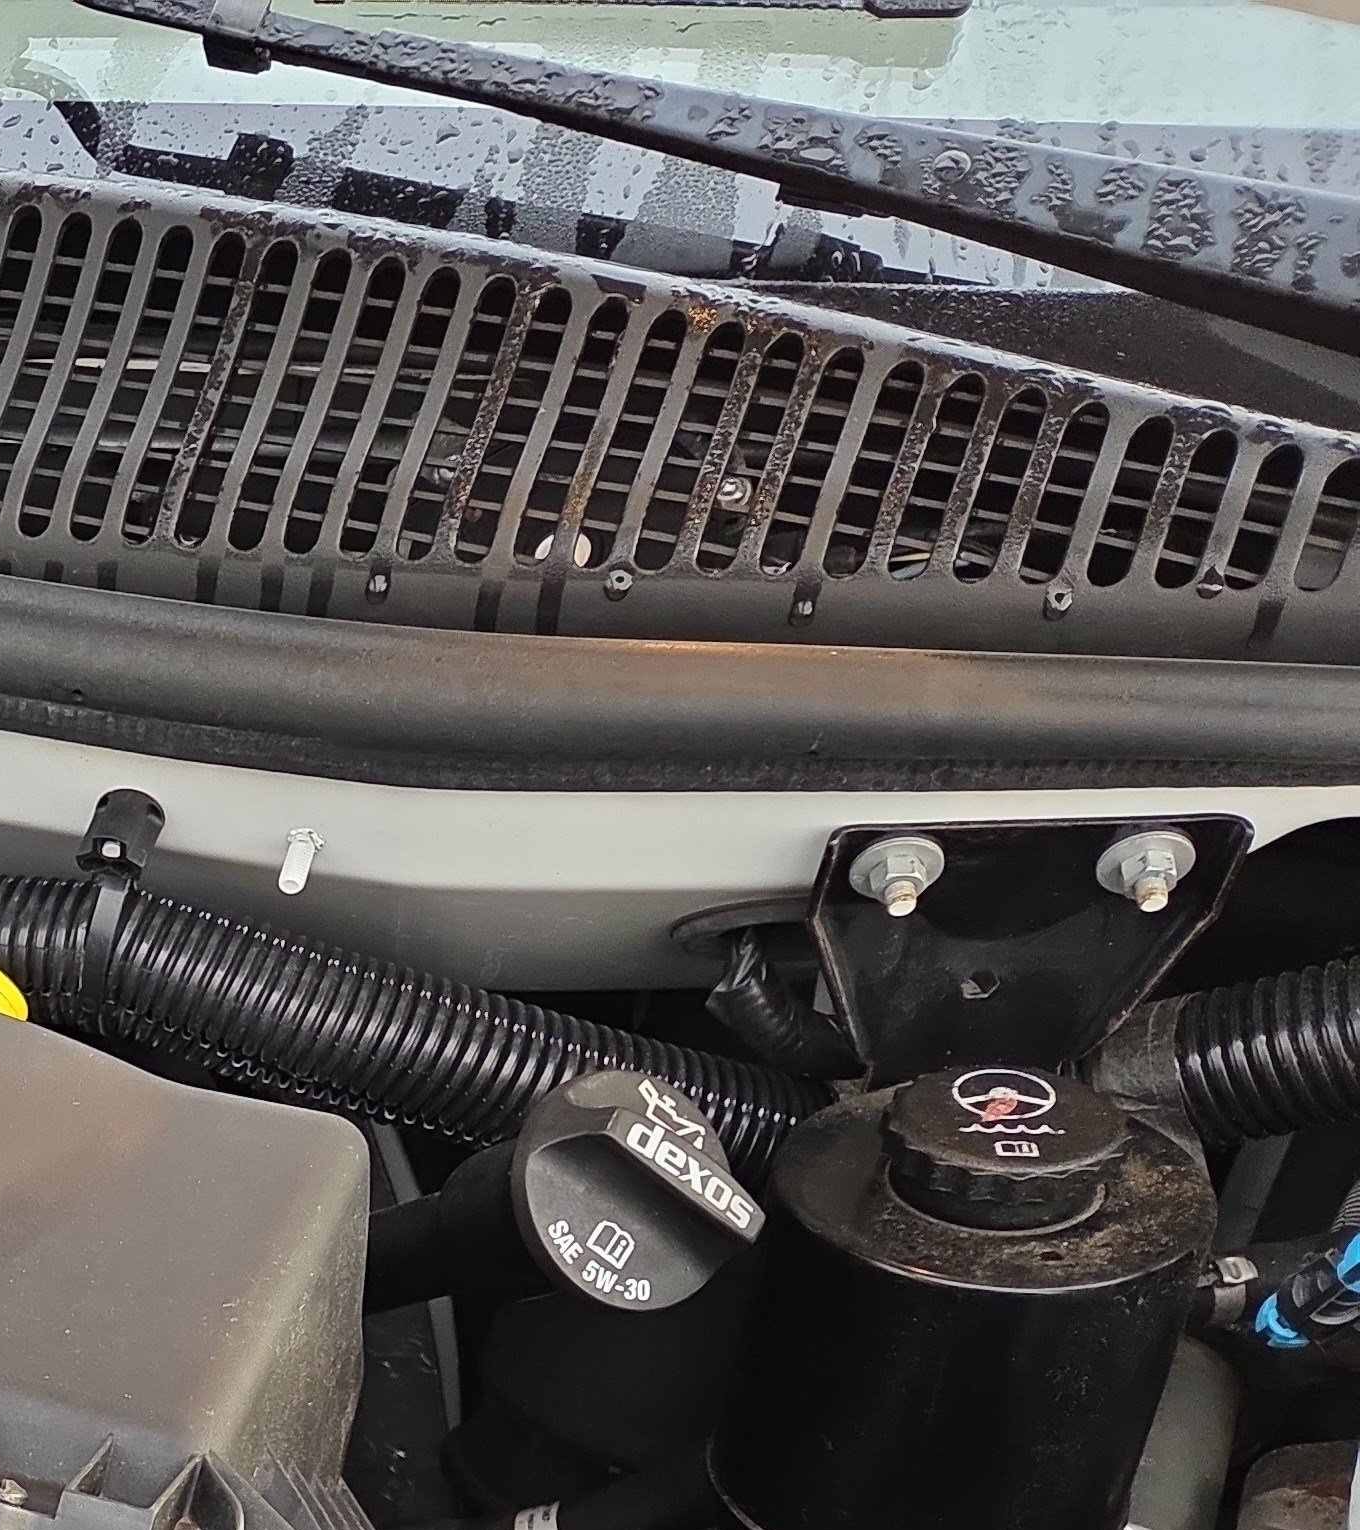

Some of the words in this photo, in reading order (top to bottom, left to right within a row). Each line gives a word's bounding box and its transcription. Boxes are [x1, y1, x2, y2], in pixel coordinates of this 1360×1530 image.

[625, 1121, 756, 1230] dexos
[547, 1219, 584, 1265] SAE
[581, 1261, 652, 1302] 5W-30
